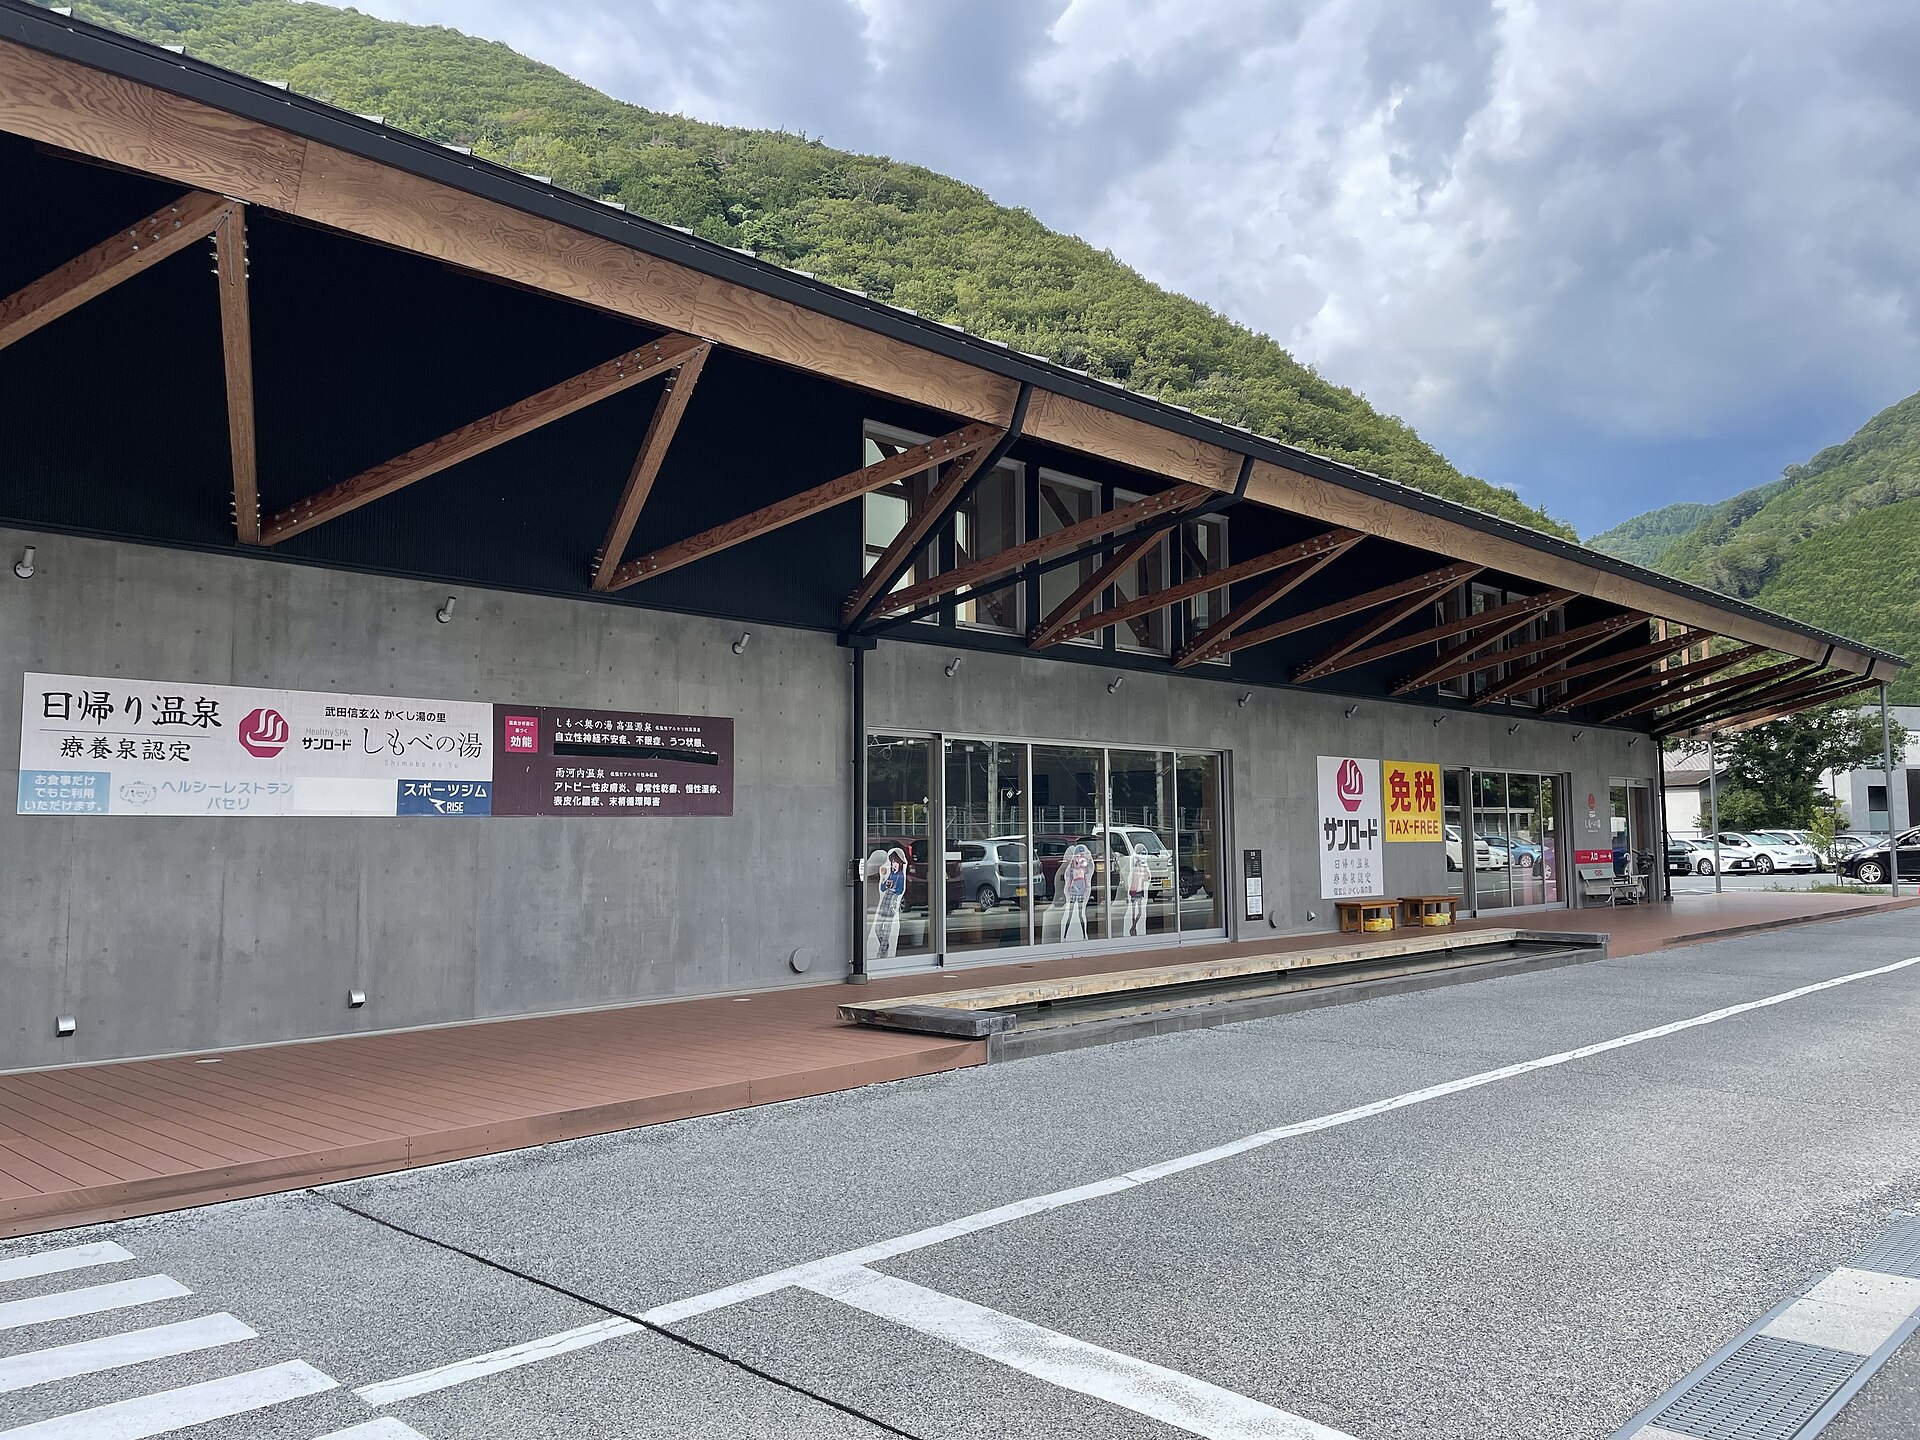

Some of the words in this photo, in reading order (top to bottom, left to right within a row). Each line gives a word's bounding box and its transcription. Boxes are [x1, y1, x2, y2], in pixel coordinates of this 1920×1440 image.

[41, 690, 222, 728] 日帰り温泉
[325, 706, 380, 720] 武田信玄公
[384, 709, 446, 723] かくし湯の里
[305, 727, 334, 738] Healthy
[334, 728, 349, 737] SPA
[60, 736, 191, 762] 療養泉認定
[302, 737, 352, 751] サンロード
[363, 727, 483, 759] しもべの湯
[510, 735, 533, 748] 効能
[35, 774, 96, 786] お食事だけ
[555, 767, 605, 779] 雨河内温泉
[35, 787, 95, 799] でもご利用
[161, 780, 293, 795] ヘルシーレストラン
[403, 782, 488, 798] スポーツジム
[1389, 768, 1437, 813] 免税
[24, 800, 102, 812] いただけます。
[446, 801, 464, 812] RISE
[1323, 817, 1378, 851] サンロード
[1389, 819, 1439, 835] TAX-FREE
